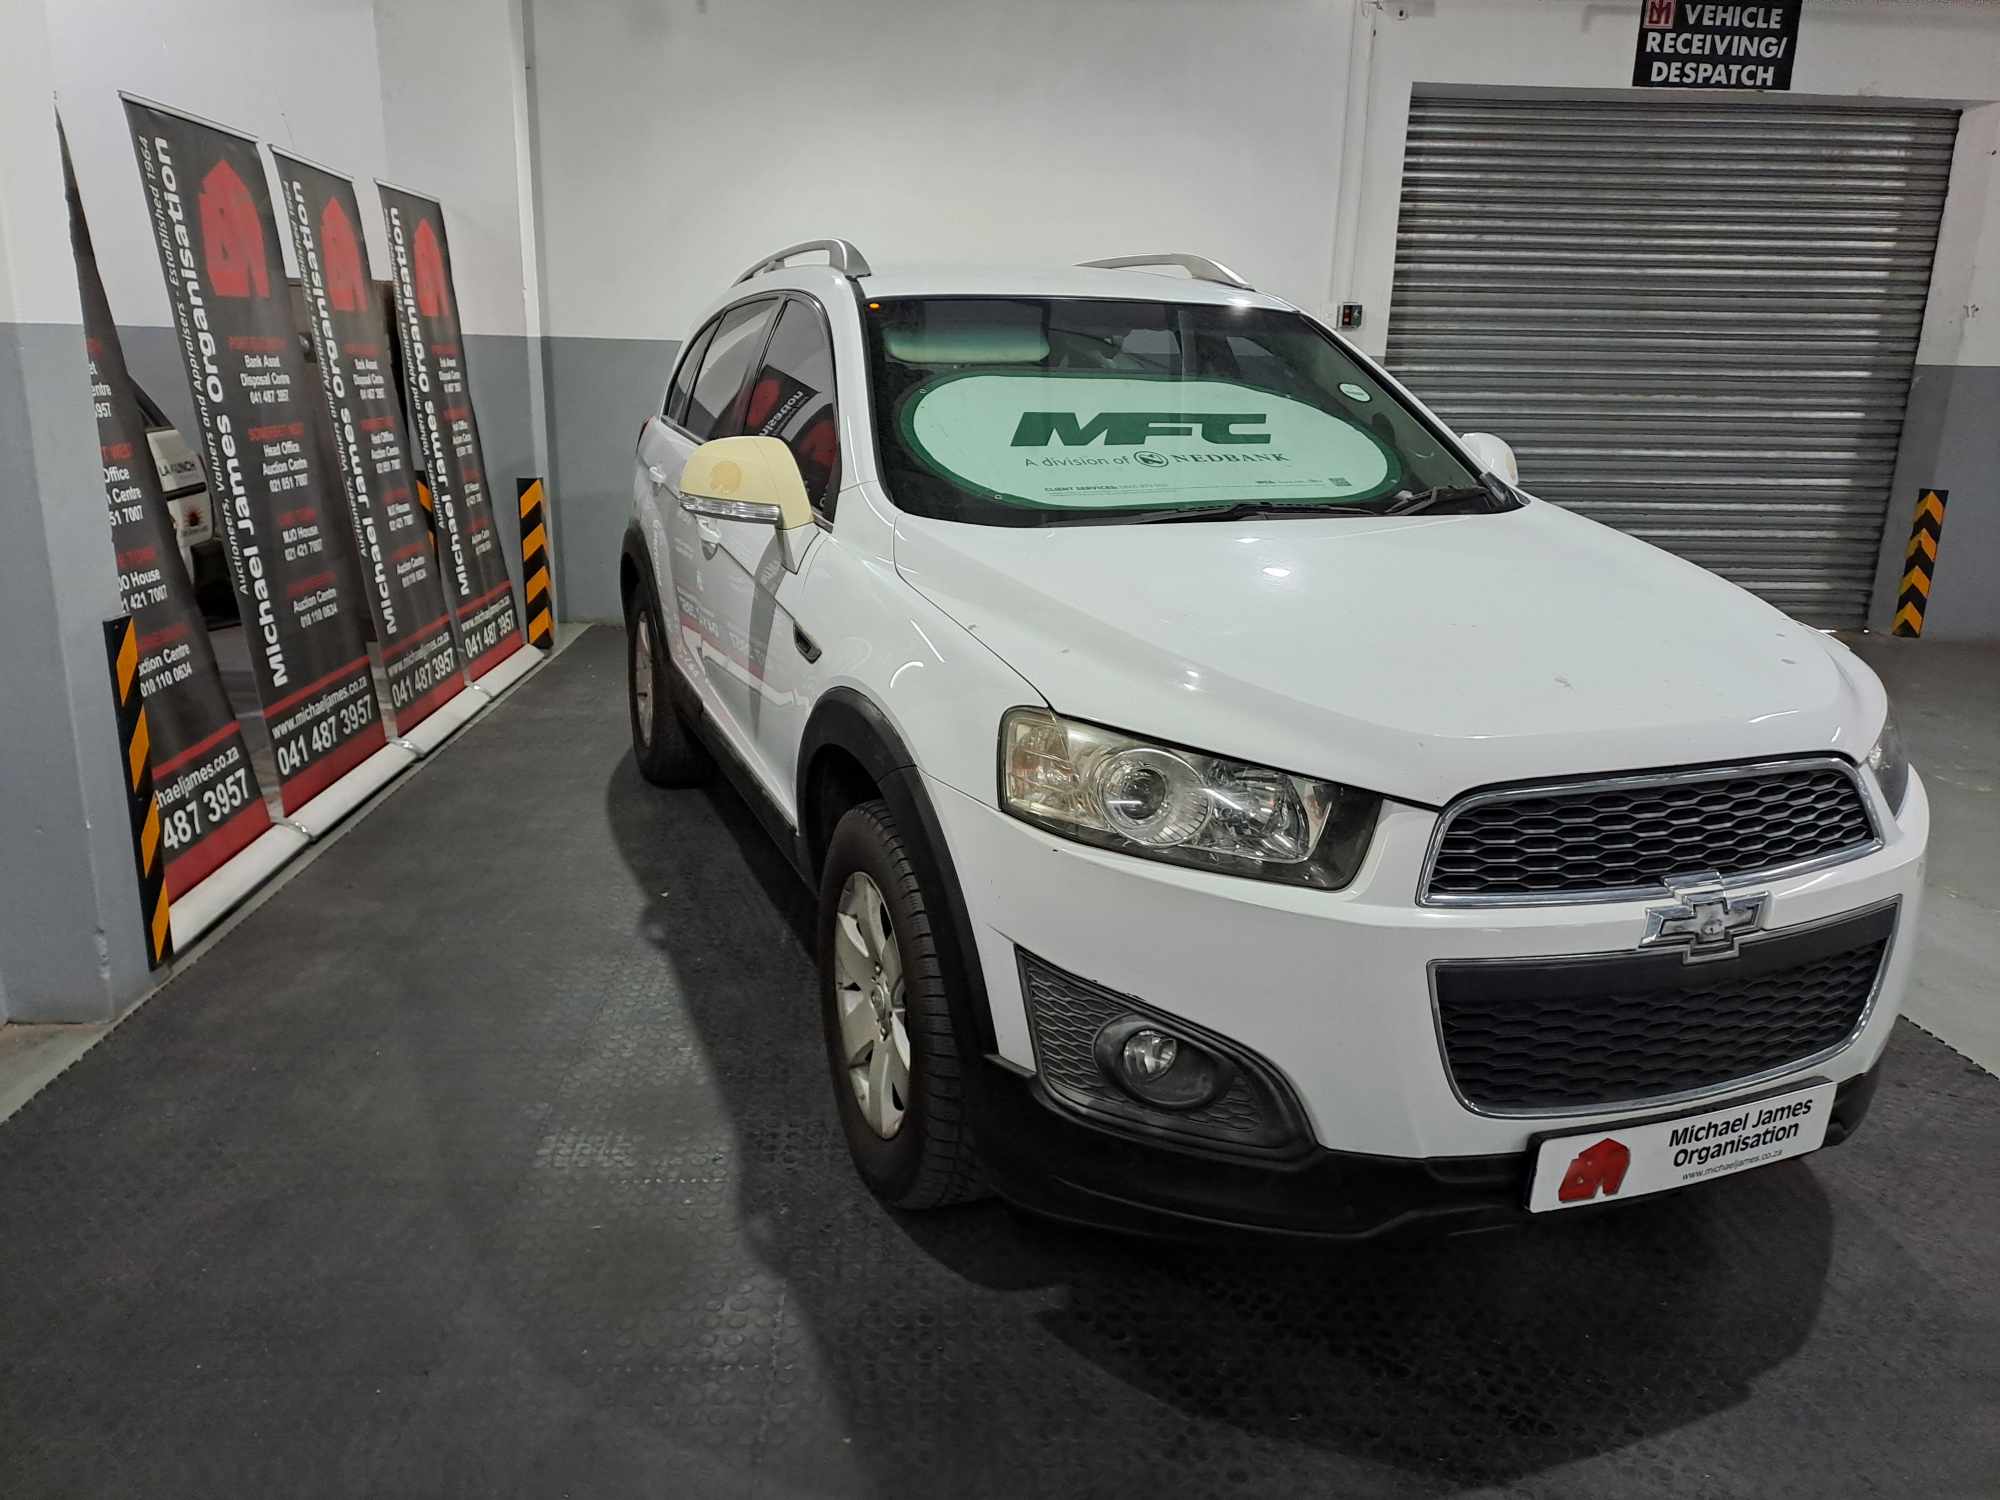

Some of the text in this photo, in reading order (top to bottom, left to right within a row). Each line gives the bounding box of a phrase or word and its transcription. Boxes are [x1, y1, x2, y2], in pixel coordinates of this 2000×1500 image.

[1685, 4, 1783, 29] VEHICLE
[1646, 31, 1788, 58] RECEIVING/
[1651, 61, 1774, 86] DESPATCH
[137, 135, 156, 181] 1964
[149, 181, 181, 287] Established
[292, 181, 345, 399] Organisation
[390, 207, 430, 393] Organisation
[177, 302, 204, 392] Appraisers
[95, 402, 111, 418] 957
[154, 136, 289, 688] Michael James Organisation
[196, 395, 211, 428] and
[1010, 412, 1272, 447] MFC
[206, 431, 225, 492] Valuers
[340, 407, 370, 509] James
[424, 400, 449, 488] James
[1025, 453, 1290, 468] A division of NEDBANK
[112, 486, 143, 503] Centre
[441, 494, 470, 595] Michael
[130, 569, 160, 588] House
[130, 591, 148, 609] 421
[362, 517, 397, 635] Michael
[465, 631, 483, 659] 041
[483, 621, 497, 647] 487
[156, 671, 173, 689] 110
[391, 647, 455, 708] 041 487 3957
[271, 676, 368, 739] www.michaeljames.co.za
[277, 694, 372, 775] 041 487 3957
[155, 746, 240, 811] haeljames.co.za
[163, 767, 249, 849] 487 3957
[1669, 1099, 1813, 1147] Michael James
[1673, 1123, 1799, 1168] Organisation
